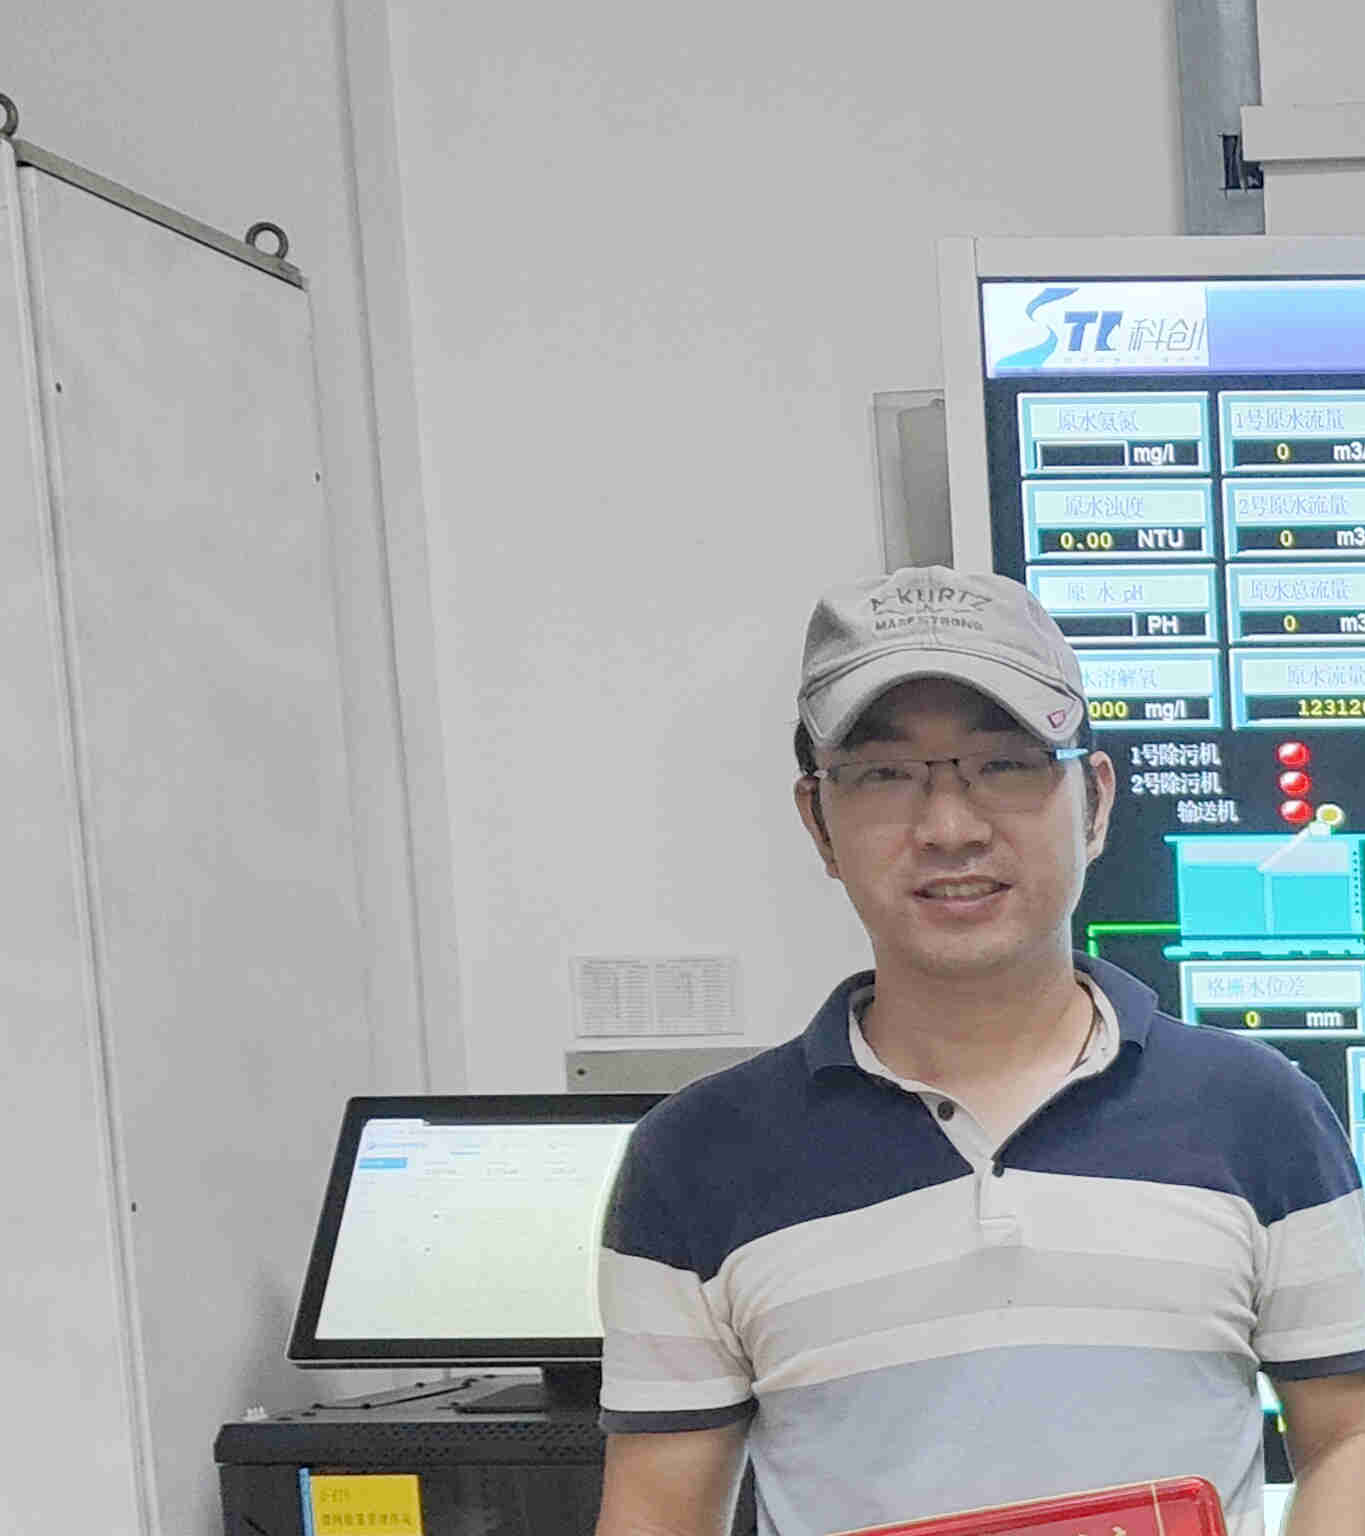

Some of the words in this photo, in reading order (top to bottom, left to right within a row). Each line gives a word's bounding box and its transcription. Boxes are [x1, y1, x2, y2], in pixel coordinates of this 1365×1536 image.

[1129, 317, 1206, 352] 科创
[1133, 443, 1175, 464] mg/l
[1276, 443, 1289, 461] 0
[1059, 531, 1113, 549] 0.00
[1136, 528, 1185, 548] NTU
[1279, 529, 1294, 546] 0
[1147, 614, 1179, 635] PH
[1283, 614, 1297, 632] 0
[1144, 699, 1188, 721] mg/l
[1130, 741, 1222, 767] 1号除污机
[1130, 771, 1223, 796] 2号除污机
[1243, 1010, 1261, 1028] 0
[1305, 1011, 1344, 1028] mm
